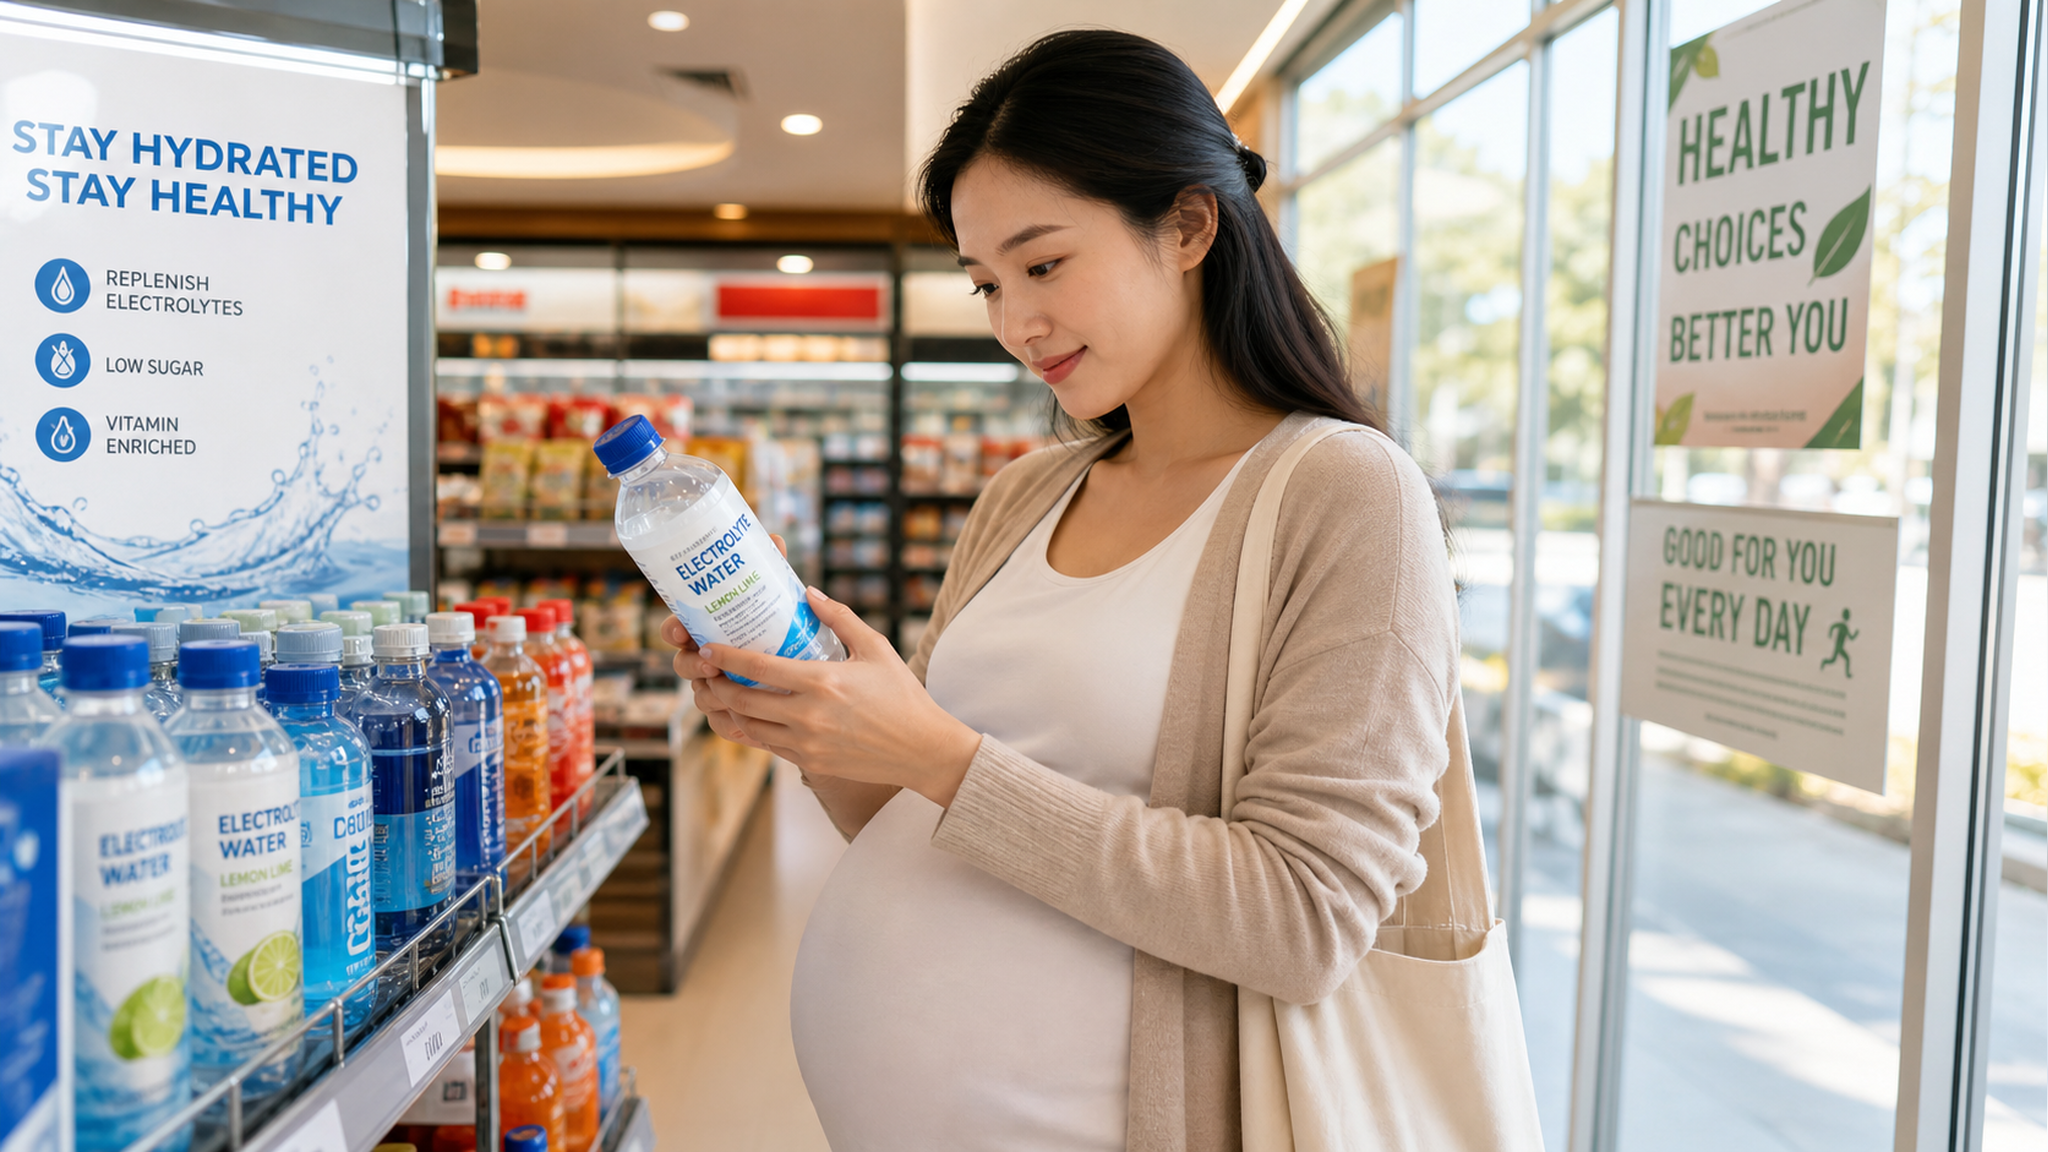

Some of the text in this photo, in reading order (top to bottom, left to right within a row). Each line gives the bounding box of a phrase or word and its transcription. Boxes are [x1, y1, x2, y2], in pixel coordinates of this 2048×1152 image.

[1678, 61, 1870, 186] HEALTHY
[12, 120, 359, 184] STAY HYDRATED
[26, 168, 343, 226] STAY HEALTHY
[1674, 200, 1807, 274] CHOICES
[106, 270, 209, 291] REPLENISH
[106, 293, 243, 316] ELECTROLYTES
[1669, 298, 1848, 363] BETTER YOU
[106, 357, 204, 376] LOW SUGAR
[106, 416, 179, 432] VITAMIN
[106, 438, 197, 455] ENRICHED
[675, 513, 751, 581] ELECTROLYTE
[1663, 526, 1836, 587] GOOD FOR YOU
[687, 552, 745, 596] WATER
[704, 587, 740, 614] LEMON
[1660, 581, 1811, 656] EVERY DAY
[219, 831, 287, 859] WATER
[100, 852, 172, 887] WATER
[220, 859, 293, 888] LEMON LIME
